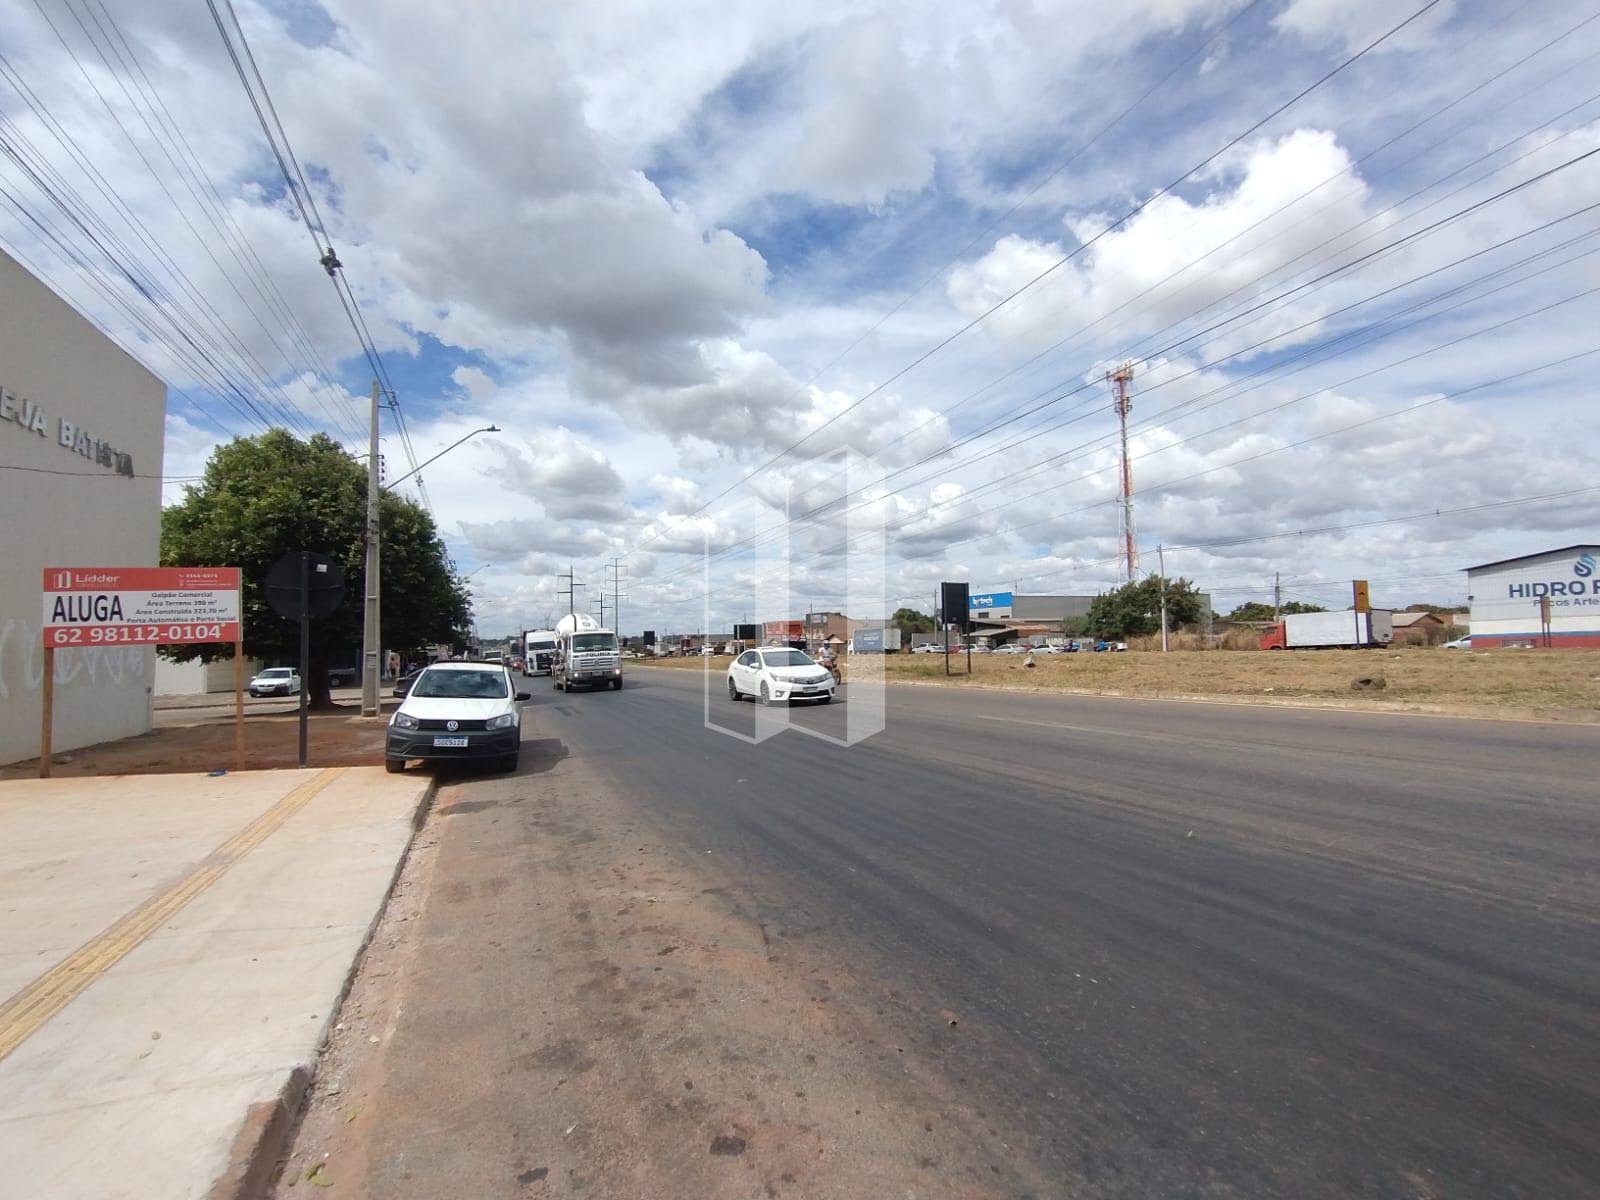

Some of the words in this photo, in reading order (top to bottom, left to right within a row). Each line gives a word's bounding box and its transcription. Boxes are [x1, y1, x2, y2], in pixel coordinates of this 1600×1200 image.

[1509, 581, 1585, 598] HIDRO
[52, 594, 124, 623] ALUGA
[54, 628, 83, 643] 62
[90, 625, 222, 642] 98112-0104
